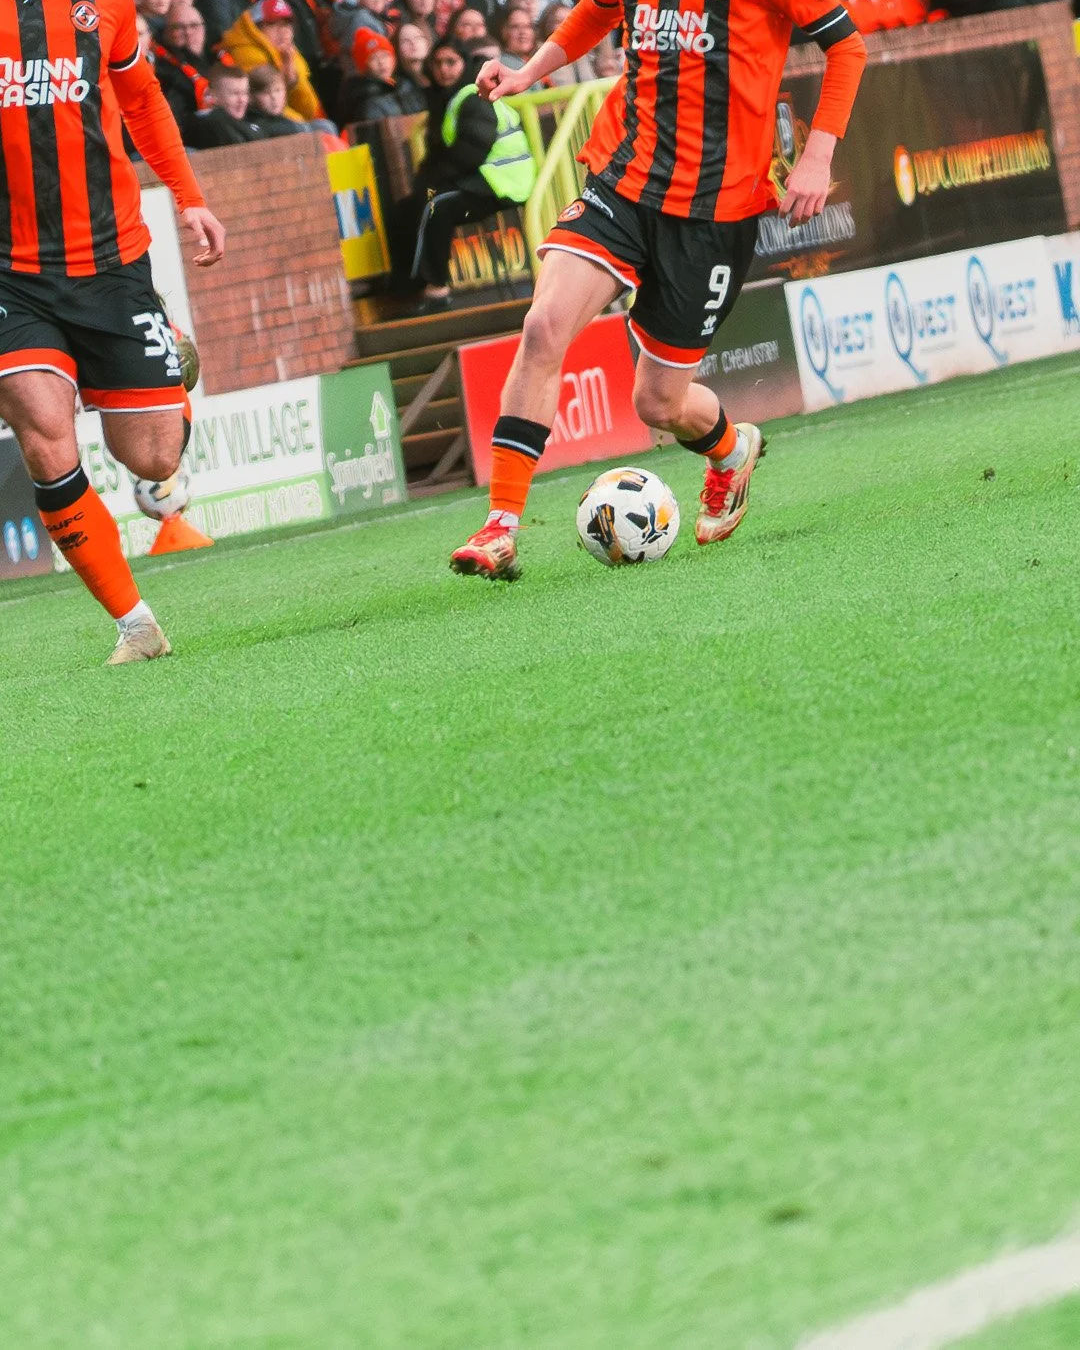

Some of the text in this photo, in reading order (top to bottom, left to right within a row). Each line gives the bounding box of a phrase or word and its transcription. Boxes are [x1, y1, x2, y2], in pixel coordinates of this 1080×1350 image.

[633, 3, 709, 33] QUINN
[631, 30, 715, 53] CASINO
[704, 265, 731, 309] 9
[221, 399, 315, 466] VILLAGE
